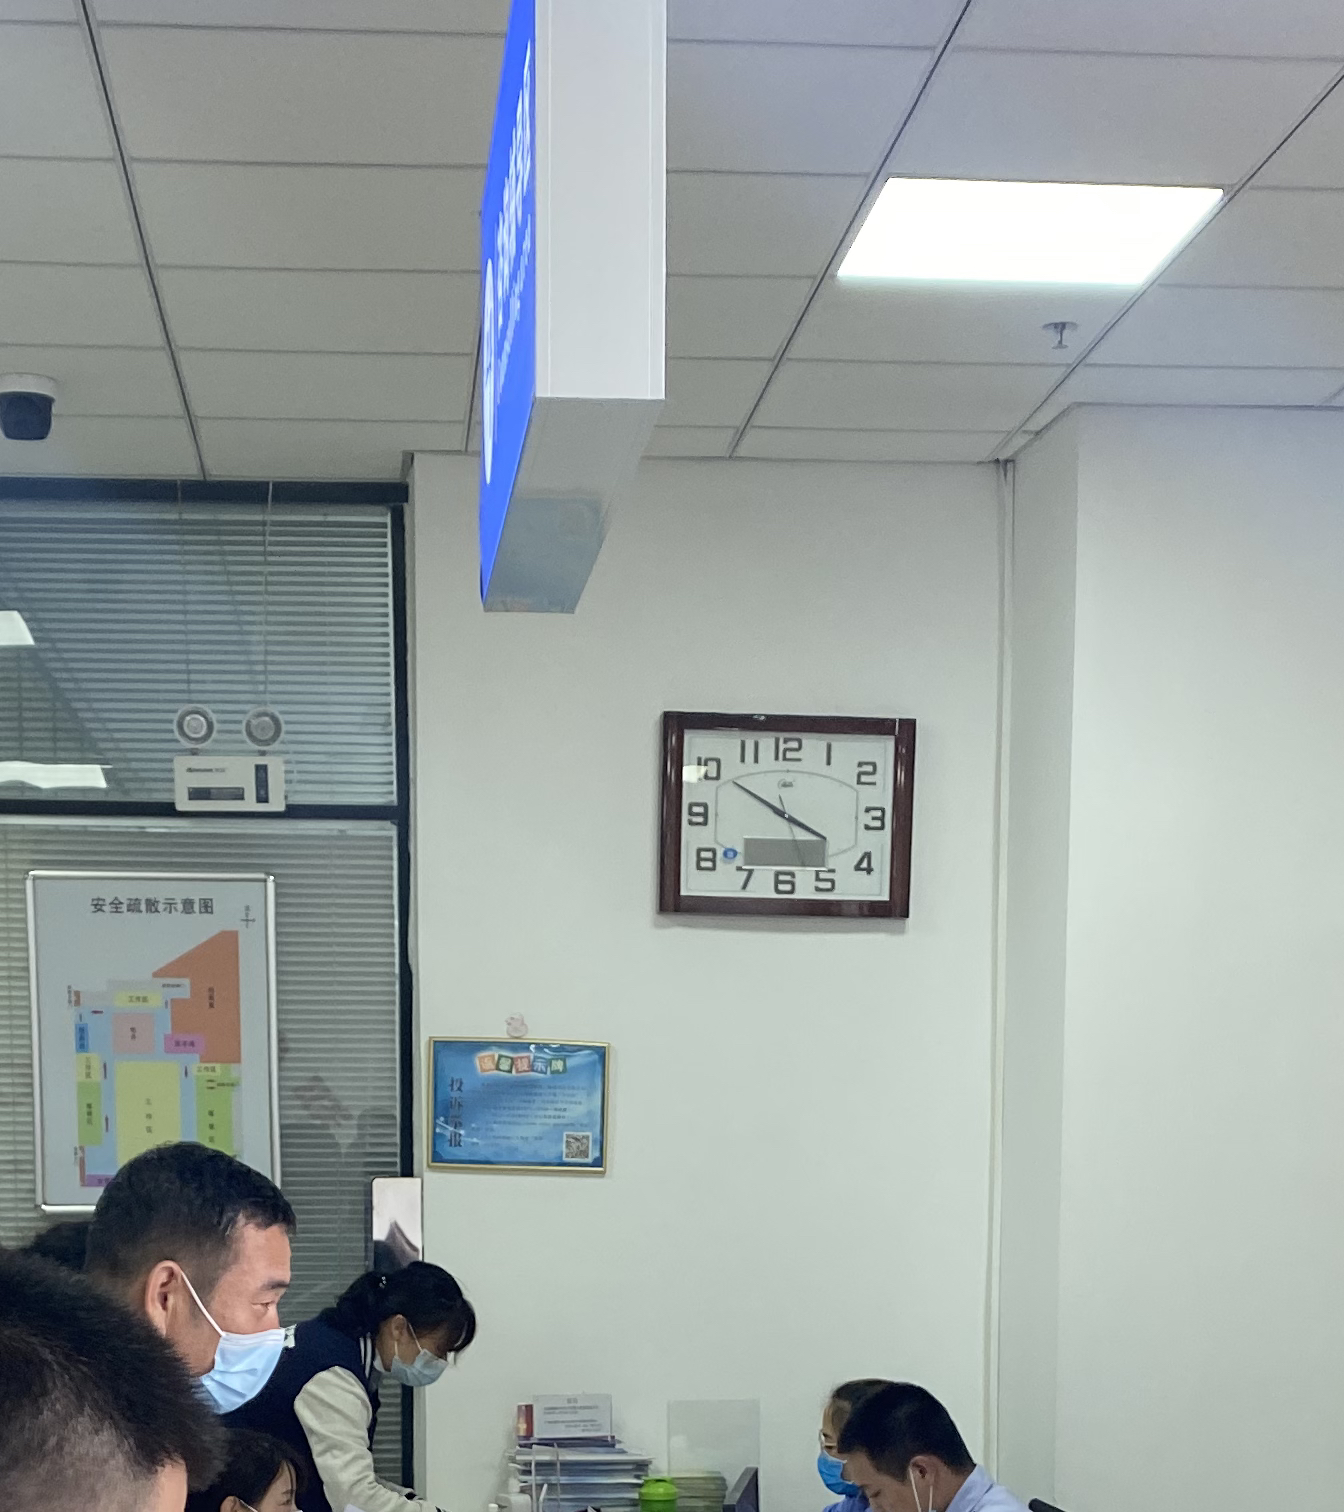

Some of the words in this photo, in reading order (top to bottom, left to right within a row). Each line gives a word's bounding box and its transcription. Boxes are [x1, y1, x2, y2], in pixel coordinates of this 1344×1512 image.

[740, 739, 759, 764] 11
[774, 736, 803, 761] 12
[697, 756, 721, 781] 10
[856, 761, 877, 785] 2
[688, 802, 709, 826] 9
[864, 806, 885, 831] 3
[696, 847, 717, 871] 8
[854, 851, 874, 875] 4
[736, 865, 754, 890] 7
[774, 871, 796, 895] 6
[814, 868, 836, 892] 5
[91, 896, 214, 915] 安全疏散示意图
